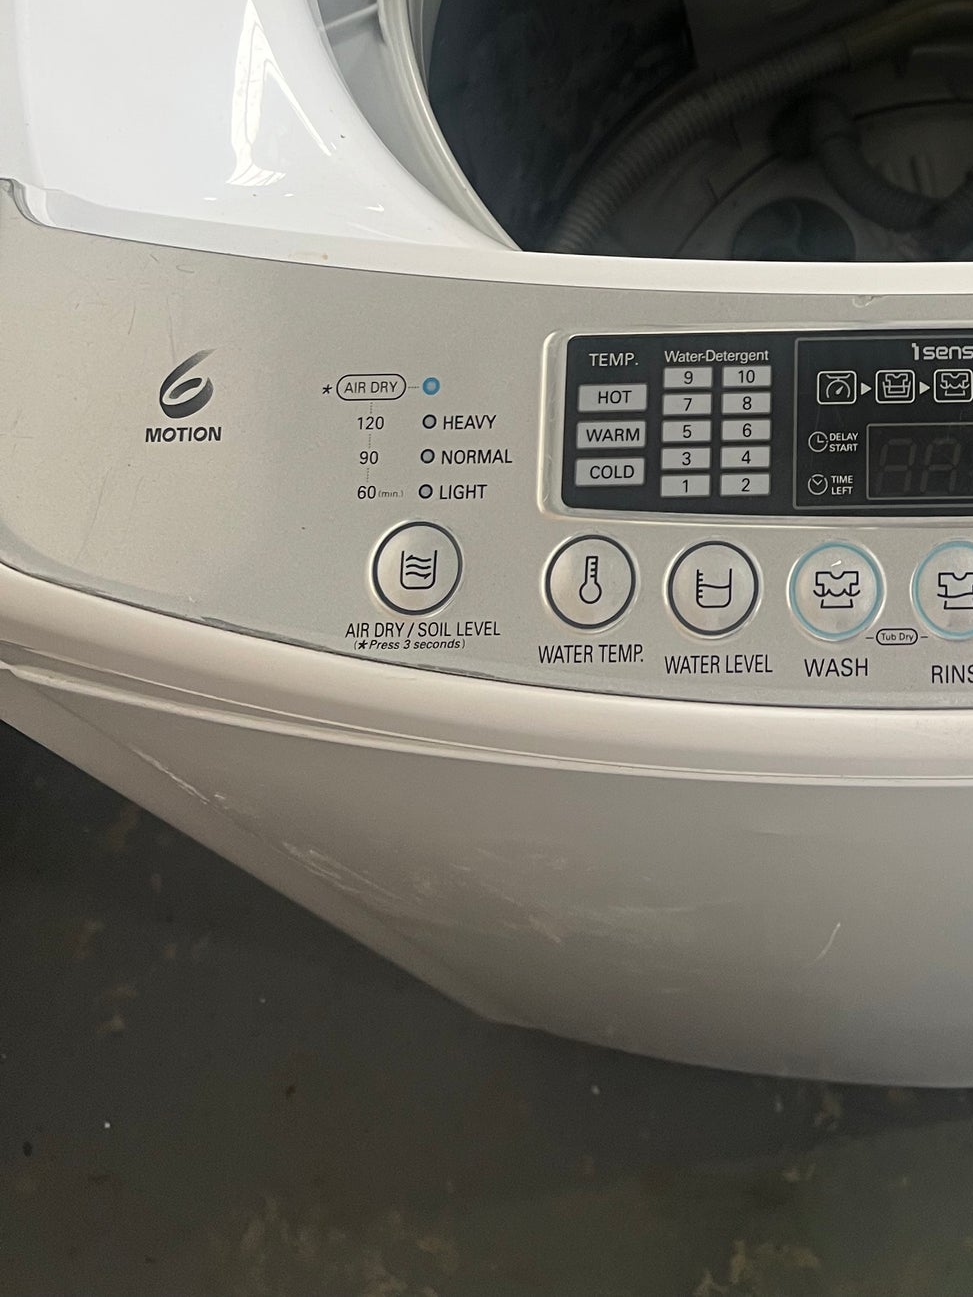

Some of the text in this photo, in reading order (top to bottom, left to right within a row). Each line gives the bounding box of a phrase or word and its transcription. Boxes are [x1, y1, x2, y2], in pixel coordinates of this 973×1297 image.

[588, 352, 639, 367] TEMP.
[664, 349, 769, 364] Water-Detergent
[683, 370, 694, 385] 9
[738, 369, 756, 384] 10
[344, 380, 398, 394] AIR DRY
[597, 390, 632, 405] HOT
[682, 397, 692, 412] 7
[742, 397, 752, 411] 8
[357, 416, 385, 430] 120
[442, 415, 497, 430] HEAVY
[144, 426, 222, 443] MOTION
[586, 428, 640, 443] WARM
[683, 424, 692, 439] 5
[742, 423, 752, 438] 6
[829, 432, 859, 442] DELAY
[829, 443, 858, 453] START
[359, 451, 379, 465] 90
[441, 449, 512, 465] NORMAL
[682, 452, 692, 466] 3
[741, 450, 751, 464] 4
[589, 464, 635, 479] COLD
[682, 479, 689, 493] 1
[741, 478, 751, 492] 2
[831, 475, 854, 485] TIME
[357, 485, 377, 499] 60
[439, 484, 487, 500] LIGHT
[831, 486, 853, 496] LEFT
[345, 621, 501, 638] AIR DRY / SOIL LEVEL
[403, 639, 411, 649] 3
[413, 638, 466, 650] seconds)
[880, 632, 915, 643] Tub Dry
[538, 643, 645, 664] WATER TEMP.
[664, 654, 773, 675] WATER LEVEL
[804, 657, 869, 678] WASH
